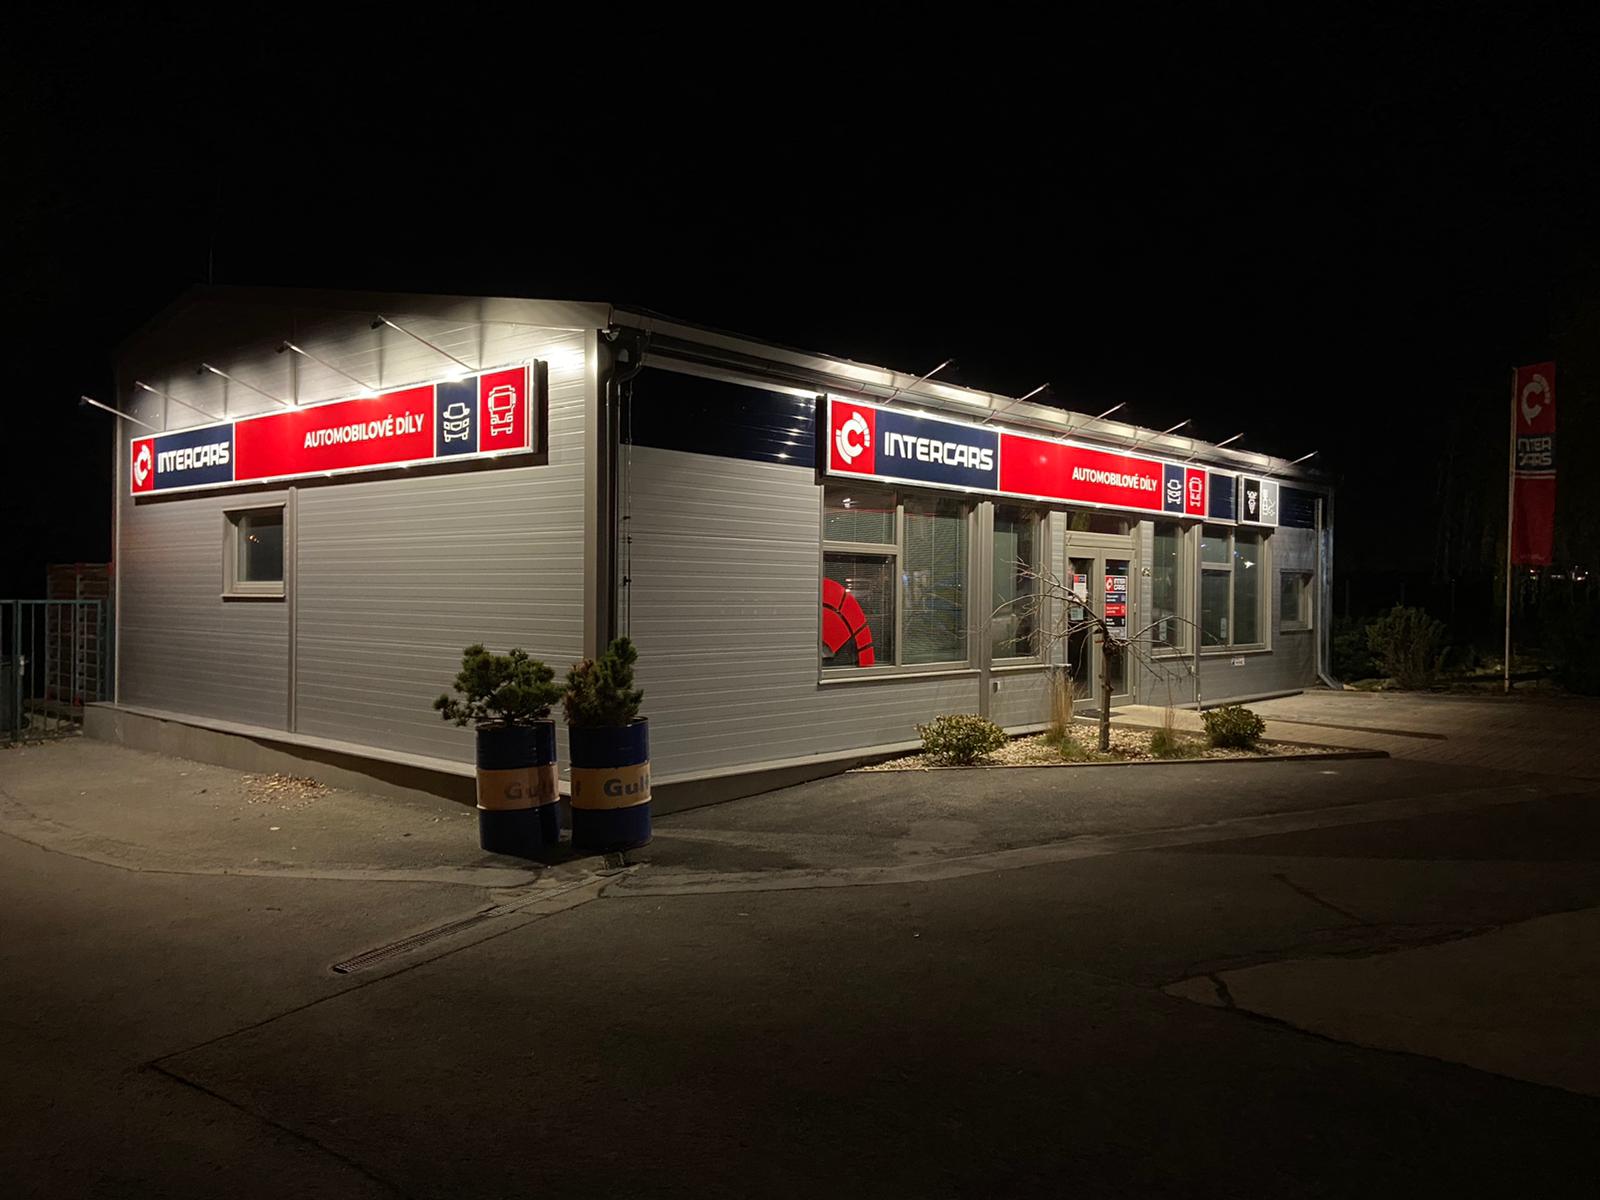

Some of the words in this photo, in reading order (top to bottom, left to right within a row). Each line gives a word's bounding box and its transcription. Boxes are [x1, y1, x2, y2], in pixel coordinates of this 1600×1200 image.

[303, 413, 394, 449] AUTOMOBILOVÉ
[395, 411, 425, 436] DÍLY
[157, 441, 230, 474] INTERCARS
[884, 431, 994, 472] INTERCARS
[1071, 466, 1140, 490] AUTOMOBILOVÉ
[1139, 475, 1158, 492] DÍLY
